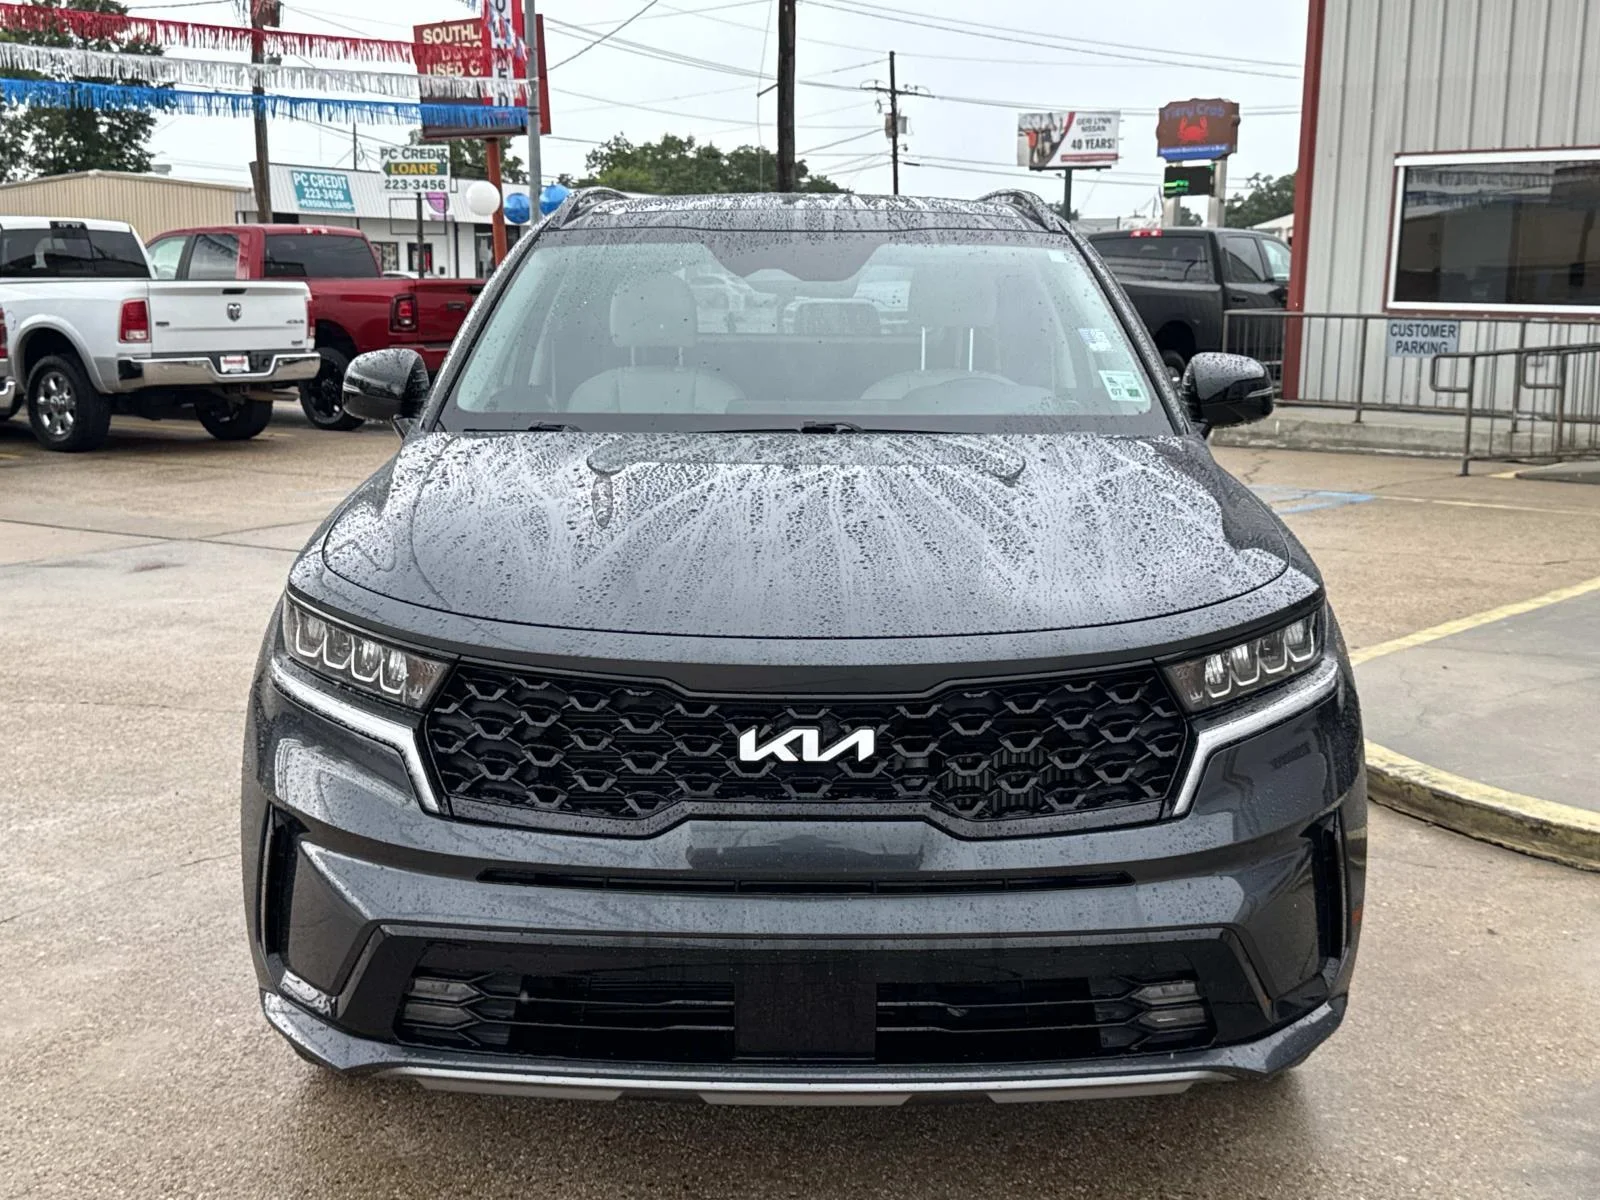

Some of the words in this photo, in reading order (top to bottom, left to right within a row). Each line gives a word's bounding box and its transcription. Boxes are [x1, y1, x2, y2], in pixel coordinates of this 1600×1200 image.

[422, 23, 482, 44] SOUTHL
[468, 59, 483, 76] C
[1071, 139, 1083, 150] 40
[380, 148, 398, 160] PC
[401, 147, 448, 160] CREDIT
[391, 163, 438, 175] LOANS
[292, 172, 309, 187] PC
[309, 173, 347, 190] CREDIT
[384, 179, 446, 190] 223-3456
[303, 187, 345, 201] 223-3456
[1390, 324, 1456, 338] CUSTOMER
[1395, 341, 1448, 354] PARKING
[738, 727, 875, 762] KIA
